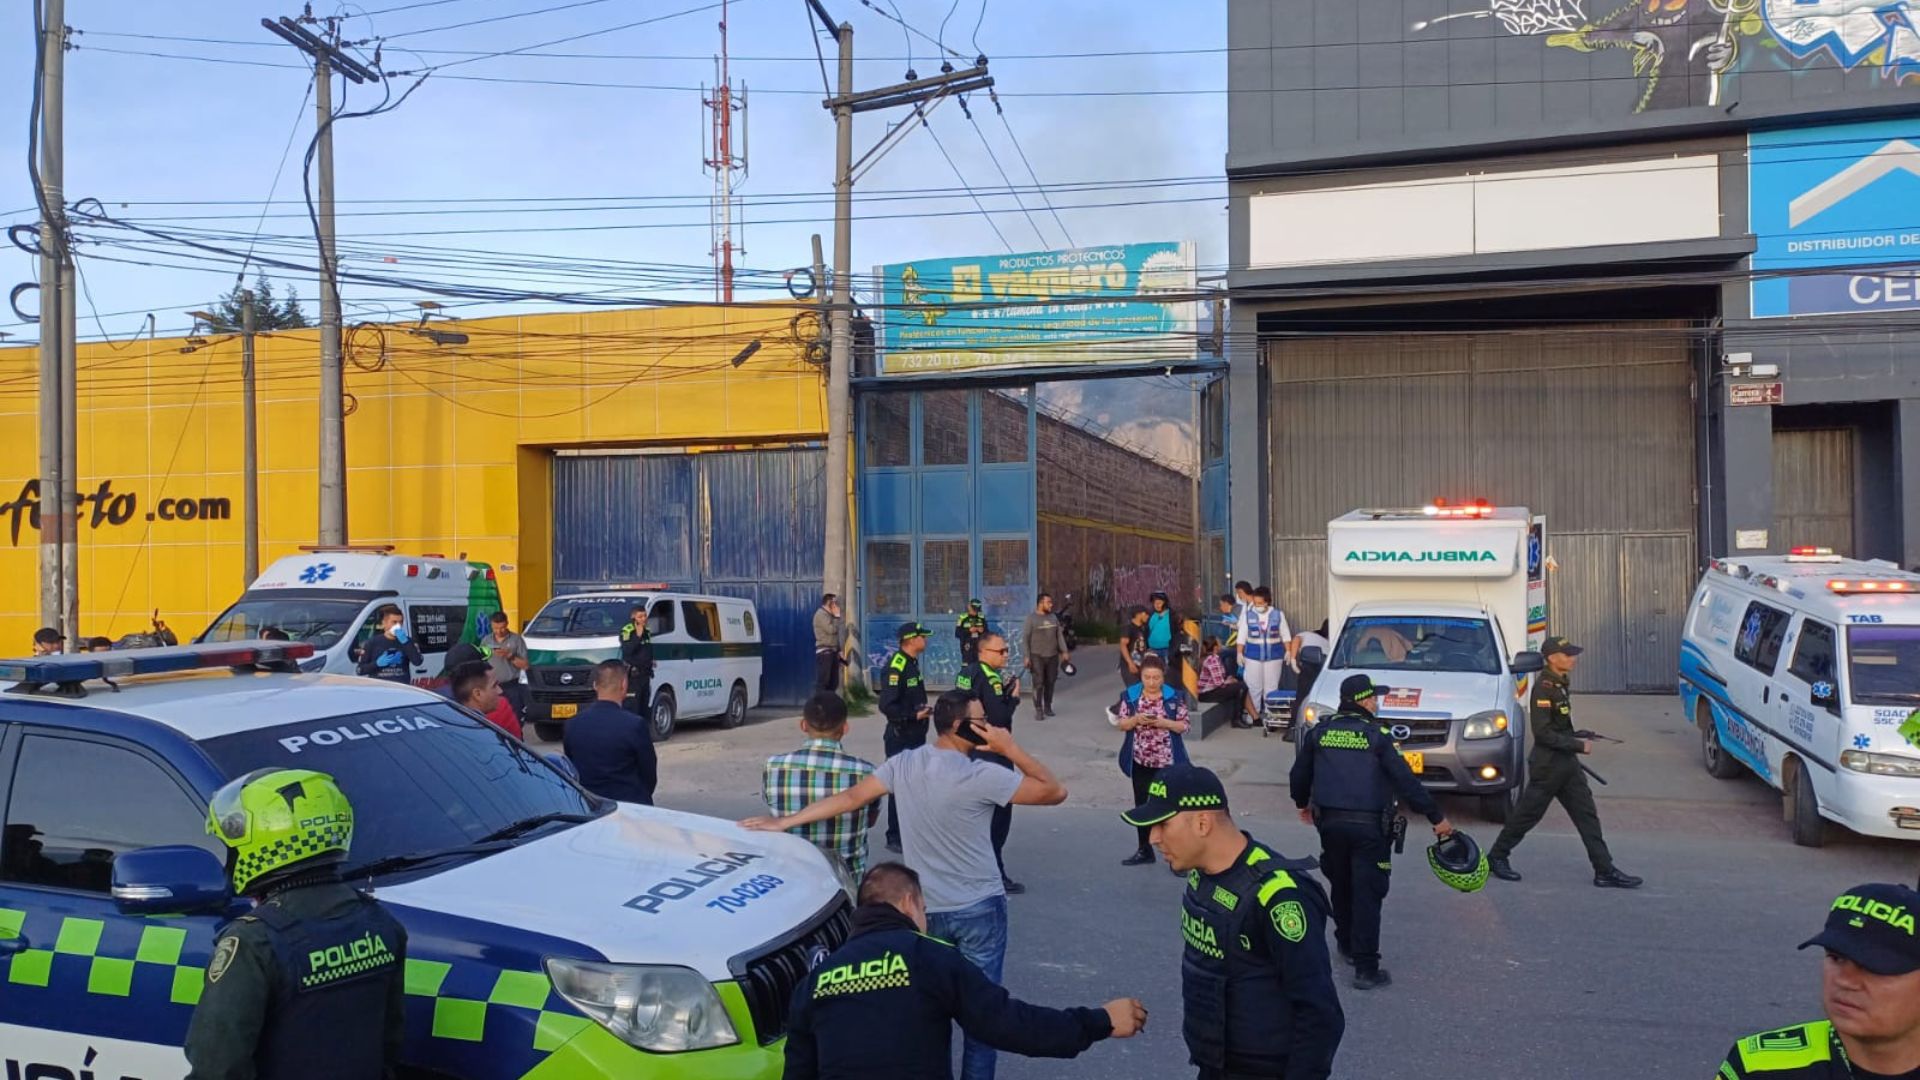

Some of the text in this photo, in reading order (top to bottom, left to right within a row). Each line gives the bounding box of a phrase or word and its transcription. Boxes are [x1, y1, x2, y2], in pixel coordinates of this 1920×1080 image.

[1000, 255, 1054, 268] PRODUCTOS
[1788, 233, 1920, 252] DISTRIBUIDOR DE
[988, 262, 1128, 302] vaquero
[1848, 269, 1920, 304] CE
[902, 354, 921, 368] 732
[1847, 614, 1883, 623] TAB
[685, 678, 722, 691] POLICIA
[278, 713, 442, 754] POLICÍA
[622, 849, 765, 915] POLICÍA
[705, 874, 785, 914] 70-0269
[1830, 894, 1915, 936] POLICÍA
[309, 930, 388, 972] POLICÍA
[816, 951, 909, 991] POLICÍA
